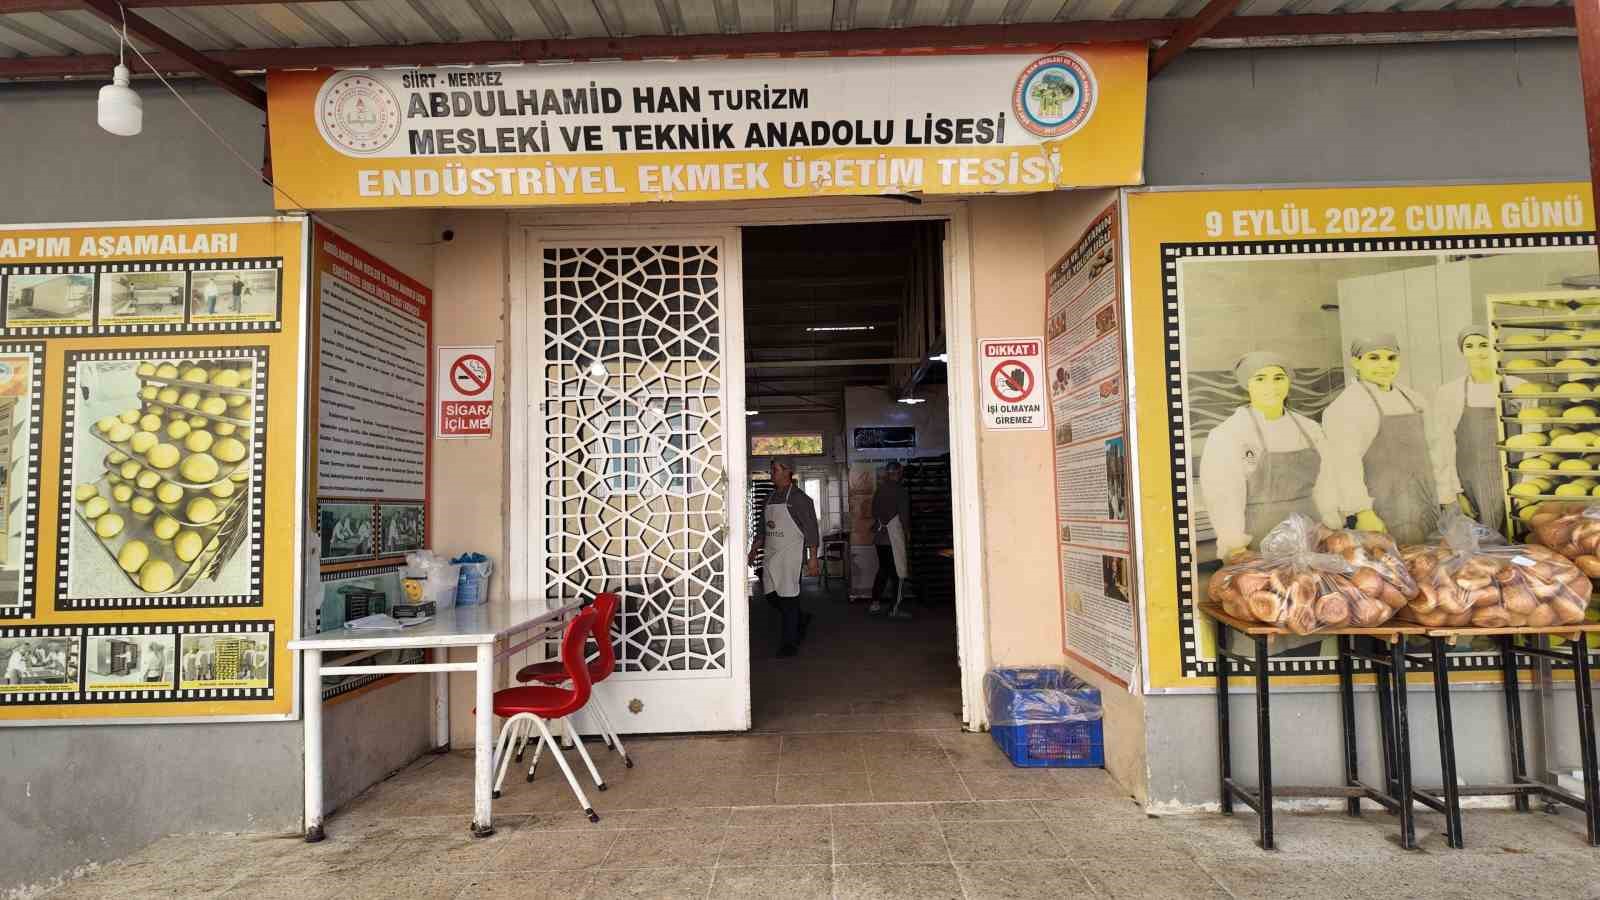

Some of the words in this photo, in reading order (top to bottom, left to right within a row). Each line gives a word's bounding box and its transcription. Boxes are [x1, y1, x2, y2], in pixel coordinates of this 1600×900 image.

[402, 70, 437, 89] SİİRT
[447, 71, 503, 87] MERKEZ
[407, 83, 622, 119] ABDULHAMİD
[633, 86, 701, 114] HAN
[708, 83, 809, 111] TURİZM
[408, 120, 550, 155] MESLEKİ
[560, 124, 603, 152] VE
[612, 117, 735, 151] TEKNİK
[745, 118, 894, 148] ANADOLU
[905, 111, 1006, 145] LİSESİ
[357, 160, 625, 198] ENDÜSTRİYEL
[638, 162, 769, 193] EKMEK
[783, 154, 923, 189] ÜRETİM
[937, 147, 1062, 186] TESİSİ
[1205, 210, 1222, 237] 9
[1232, 203, 1315, 237] EYLÜL
[1326, 206, 1396, 234] 2022
[1405, 203, 1492, 232] CUMA
[1501, 195, 1584, 229] GÜNÜ
[79, 232, 238, 258] AŞAMALARI
[988, 344, 1030, 356] DİKKAT
[987, 403, 998, 415] İŞİ
[1000, 404, 1040, 413] OLMAYAN
[995, 416, 1033, 424] GİREMEZ
[445, 416, 490, 432] İÇİLME
